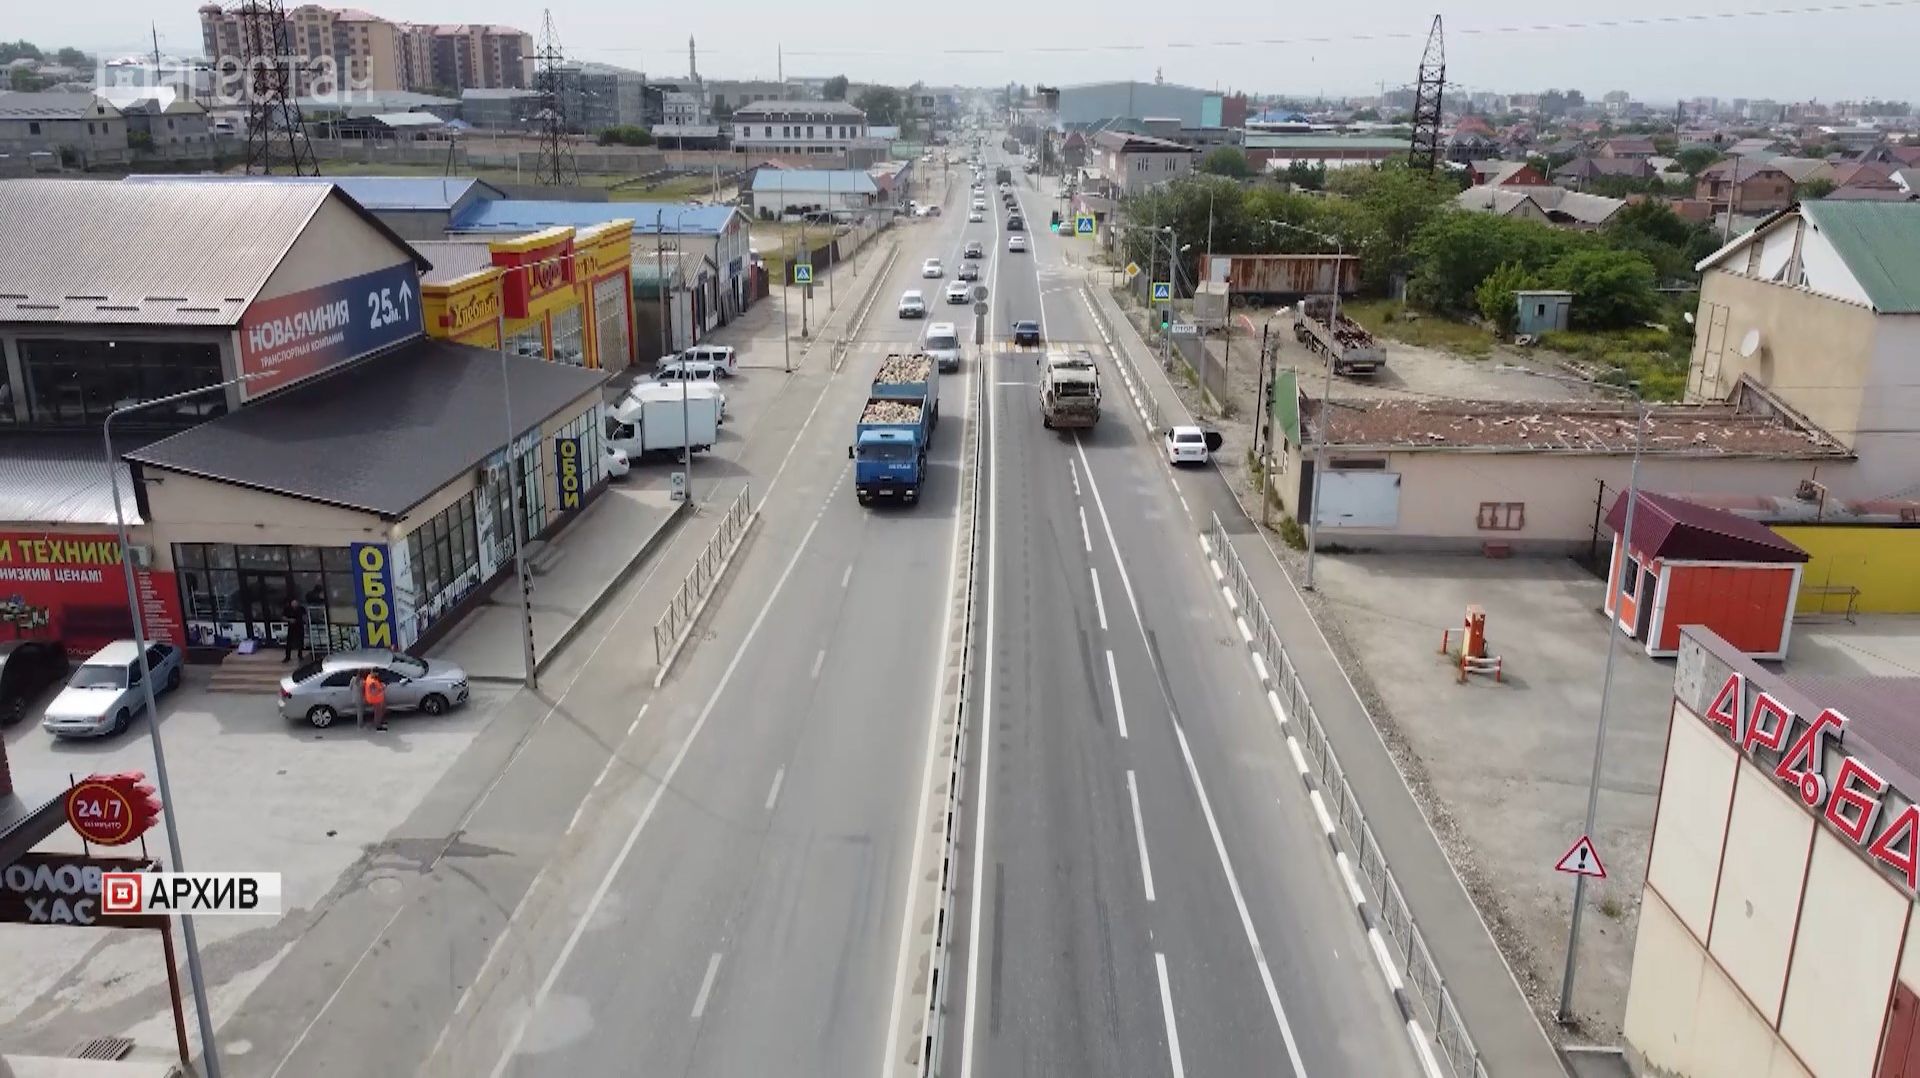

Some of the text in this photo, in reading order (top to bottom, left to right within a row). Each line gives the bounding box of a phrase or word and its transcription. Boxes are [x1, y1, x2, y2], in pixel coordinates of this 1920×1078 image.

[311, 331, 345, 352] КОМПАНИЯ
[561, 440, 580, 509] ОБОИ
[55, 569, 102, 583] ЦЕНАМ!
[359, 546, 391, 648] ОБОИ
[77, 798, 122, 819] 24/7
[24, 897, 96, 925] ХАС
